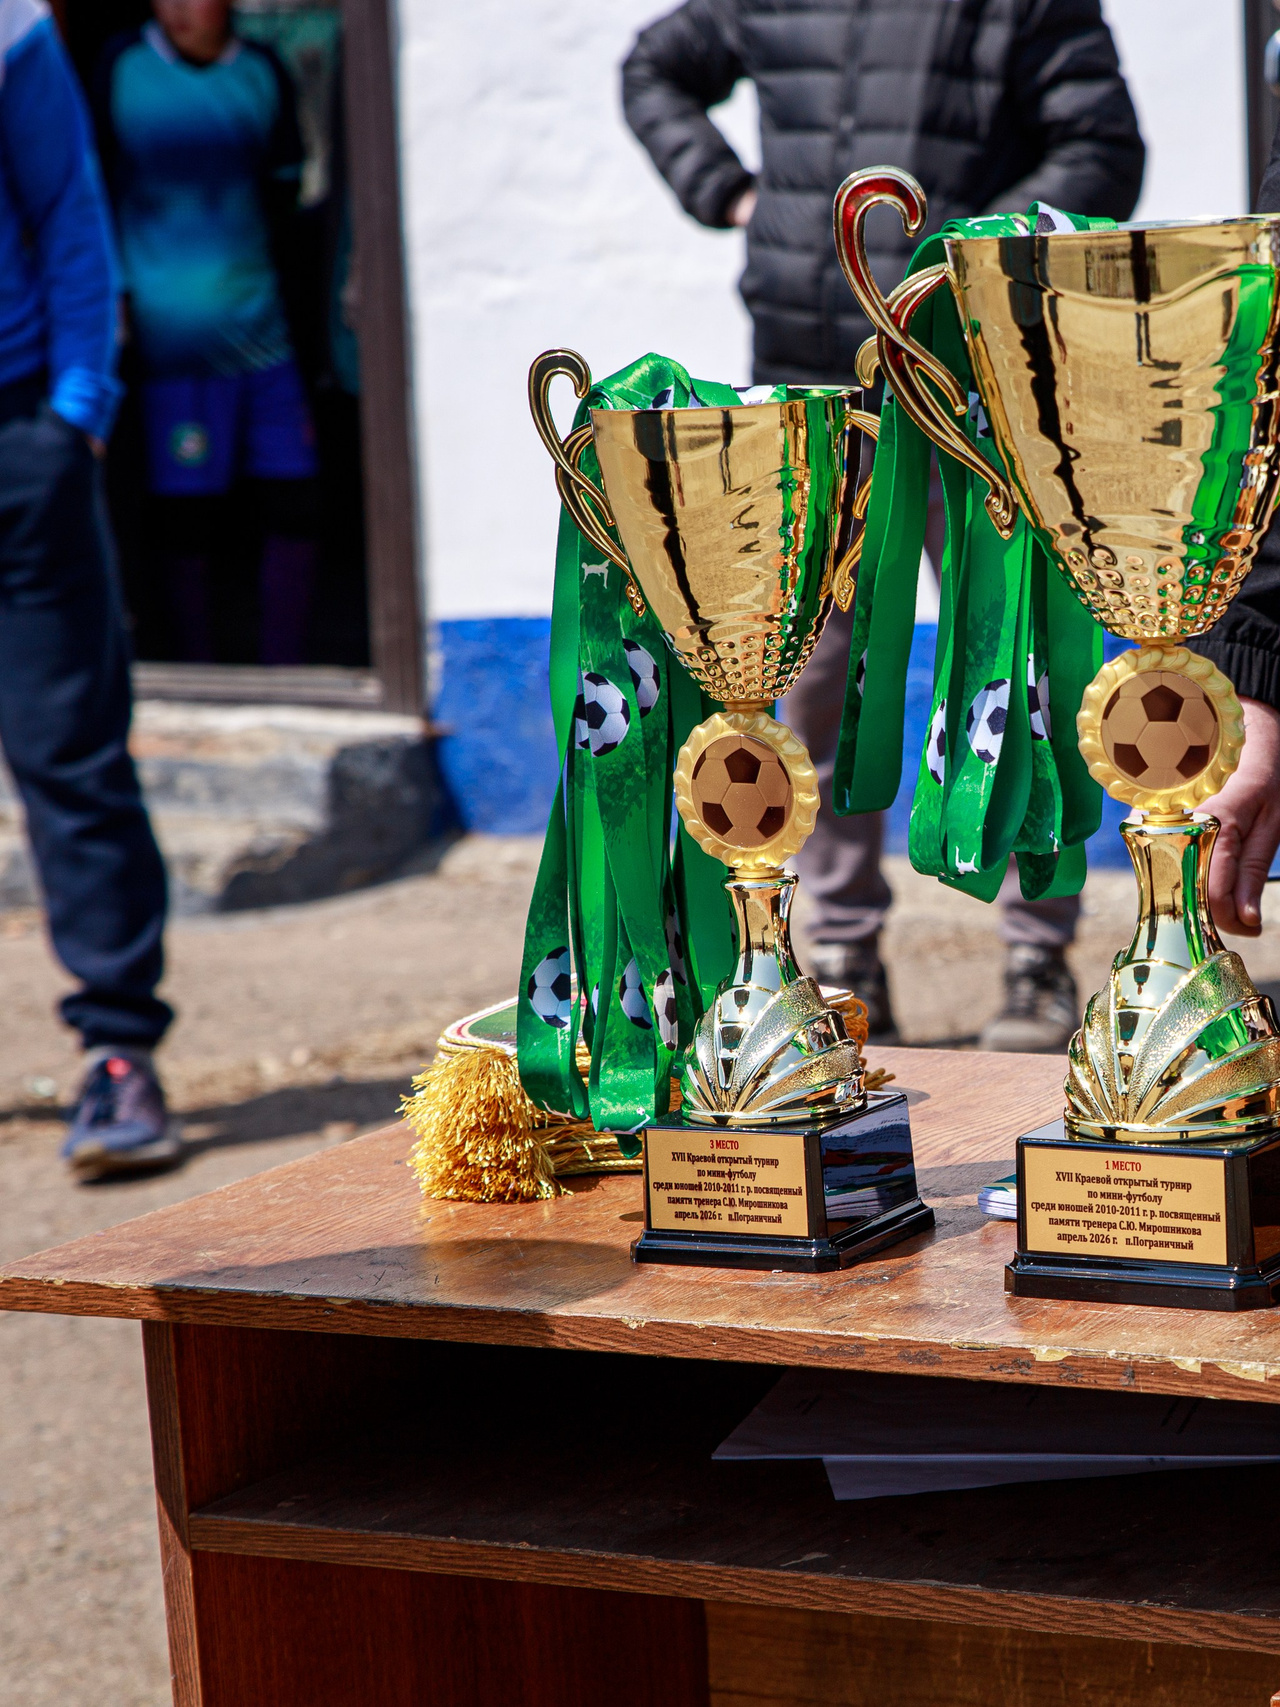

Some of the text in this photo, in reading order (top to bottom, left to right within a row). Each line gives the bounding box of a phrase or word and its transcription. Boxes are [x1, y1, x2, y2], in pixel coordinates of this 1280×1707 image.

[710, 1140, 739, 1150] 3 МЕСТО
[672, 1152, 779, 1168] XVII Краевой открытый турнир
[1105, 1161, 1141, 1171] 1 МЕСТО
[697, 1169, 756, 1181] по мини-футболу
[1056, 1172, 1192, 1192] XVII Краевой открытый турнир
[653, 1181, 672, 1192] среди
[674, 1182, 702, 1191] юношей
[704, 1182, 739, 1193] 2010-2011
[747, 1187, 752, 1196] р.
[754, 1187, 802, 1196] посвященный
[668, 1196, 788, 1210] памяти тренера С.Ю. Мирошникова
[1088, 1190, 1162, 1204] по мини-футболу
[675, 1210, 698, 1220] апрель
[700, 1211, 716, 1220] 2026
[728, 1212, 782, 1224] п.Пограничный
[1031, 1202, 1055, 1211] среди
[1058, 1203, 1093, 1213] юношей
[1096, 1204, 1140, 1216] 2010-2011
[1150, 1209, 1157, 1220] р.
[1159, 1209, 1220, 1222] посвященный
[1049, 1217, 1201, 1236] памяти тренера С.Ю. Мирошникова
[1057, 1232, 1087, 1244] апрель
[1090, 1233, 1110, 1244] 2026
[1125, 1237, 1193, 1250] п.Пограничный
